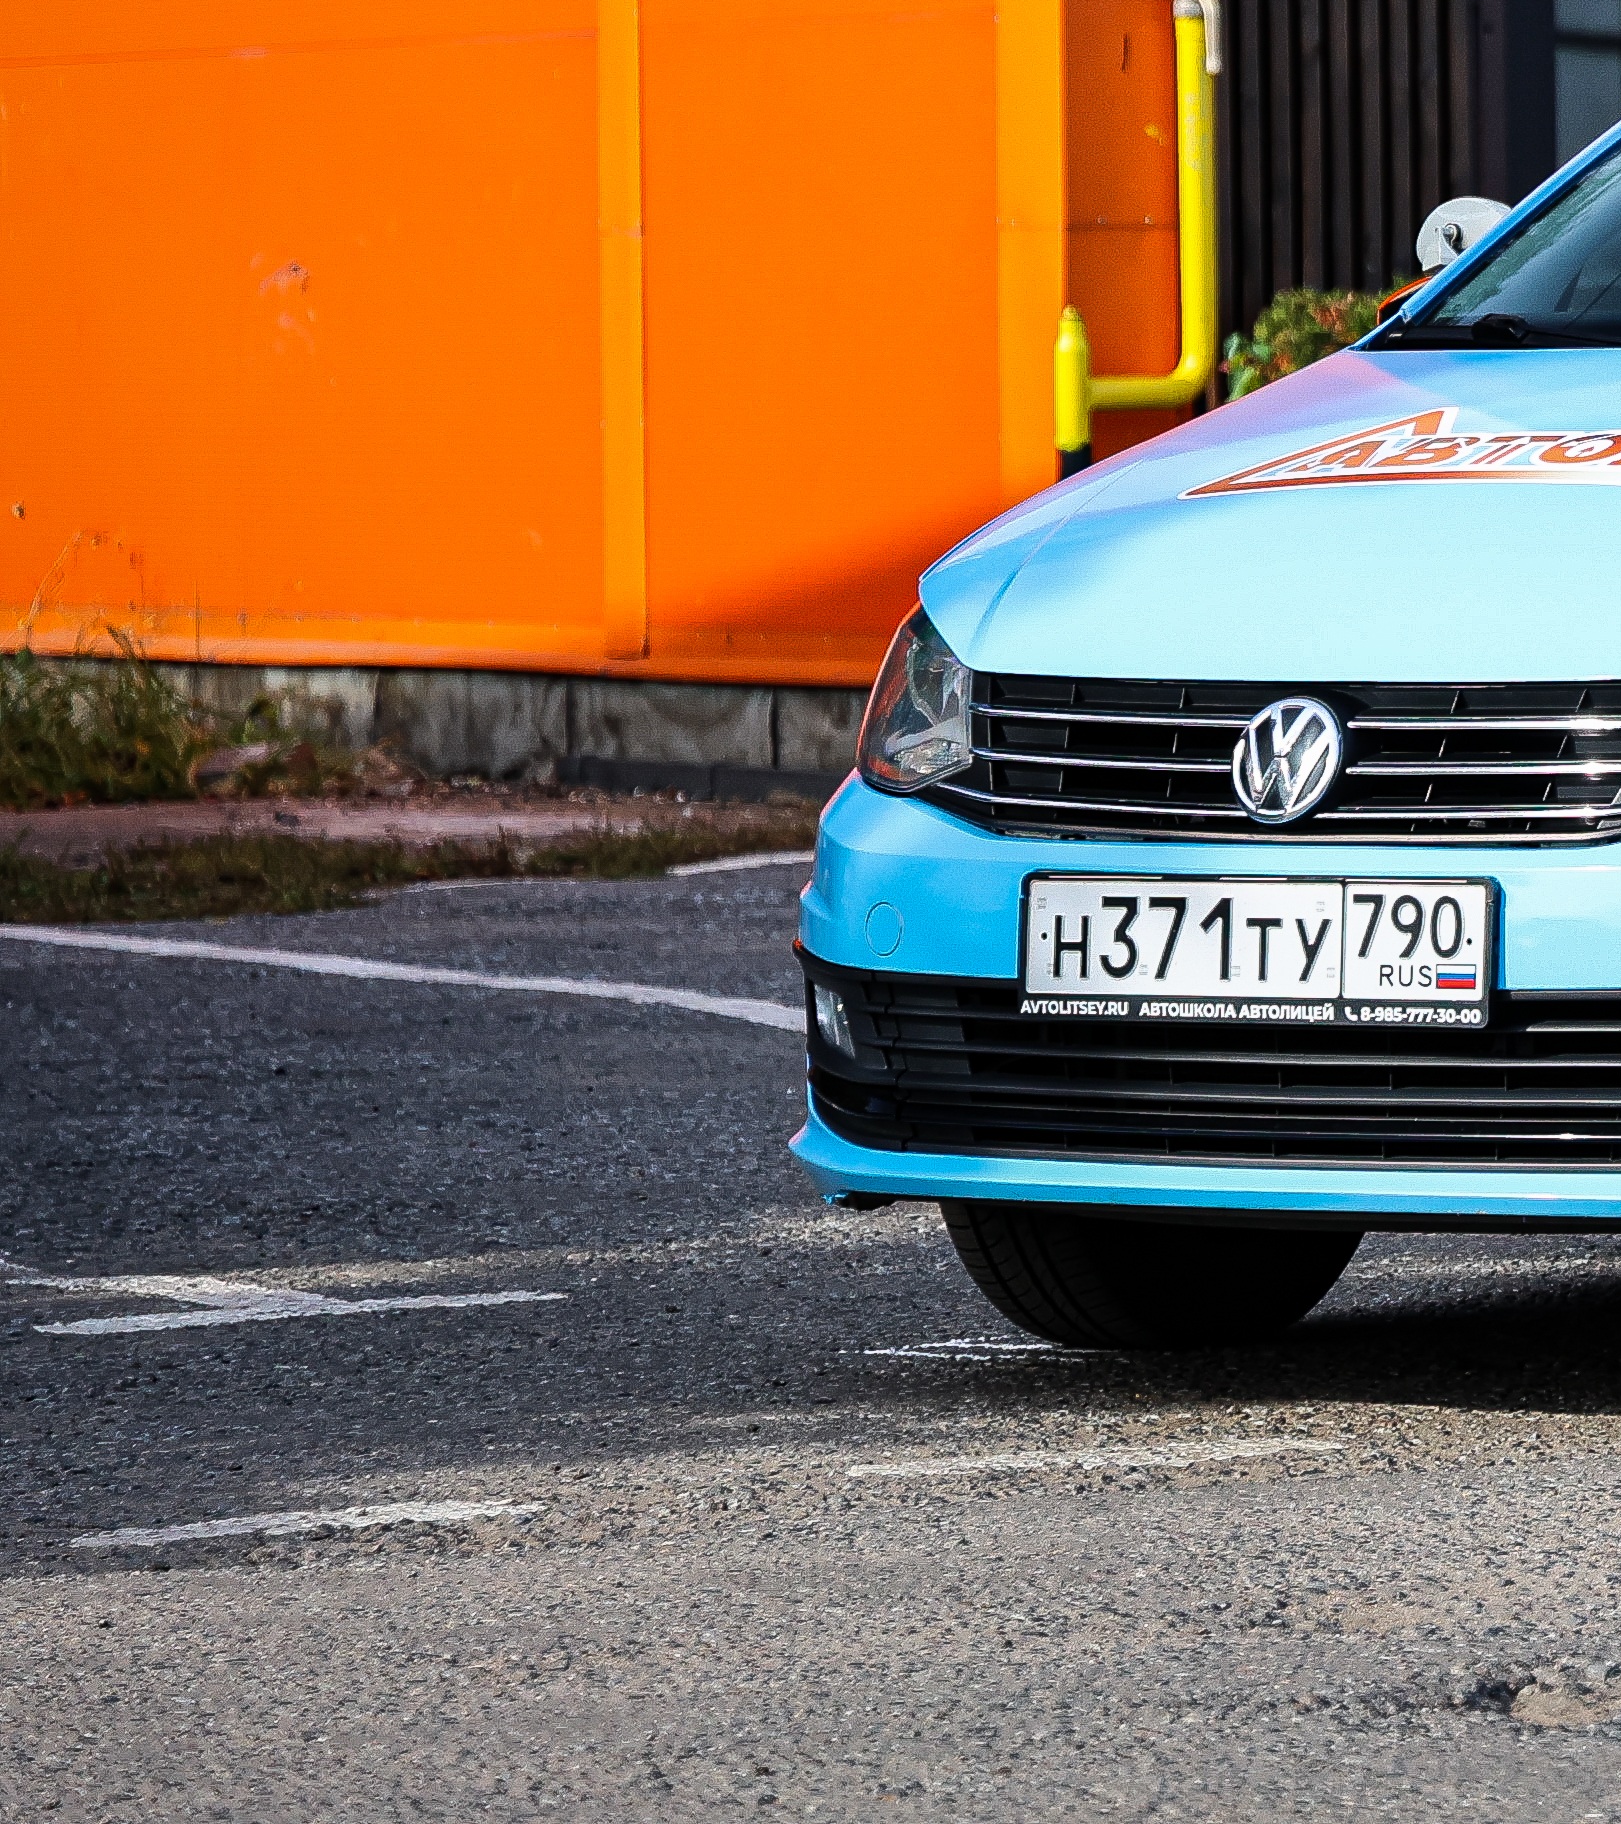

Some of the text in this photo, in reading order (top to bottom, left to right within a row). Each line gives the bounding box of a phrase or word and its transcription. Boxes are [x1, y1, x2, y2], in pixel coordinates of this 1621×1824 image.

[1352, 893, 1463, 960] 790
[1378, 964, 1434, 988] RUS
[1020, 1000, 1481, 1025] AVTOLITSEY.RU АВТОШКОЛА АВТОЛИЦЕЙ 8-985-777-30-00
